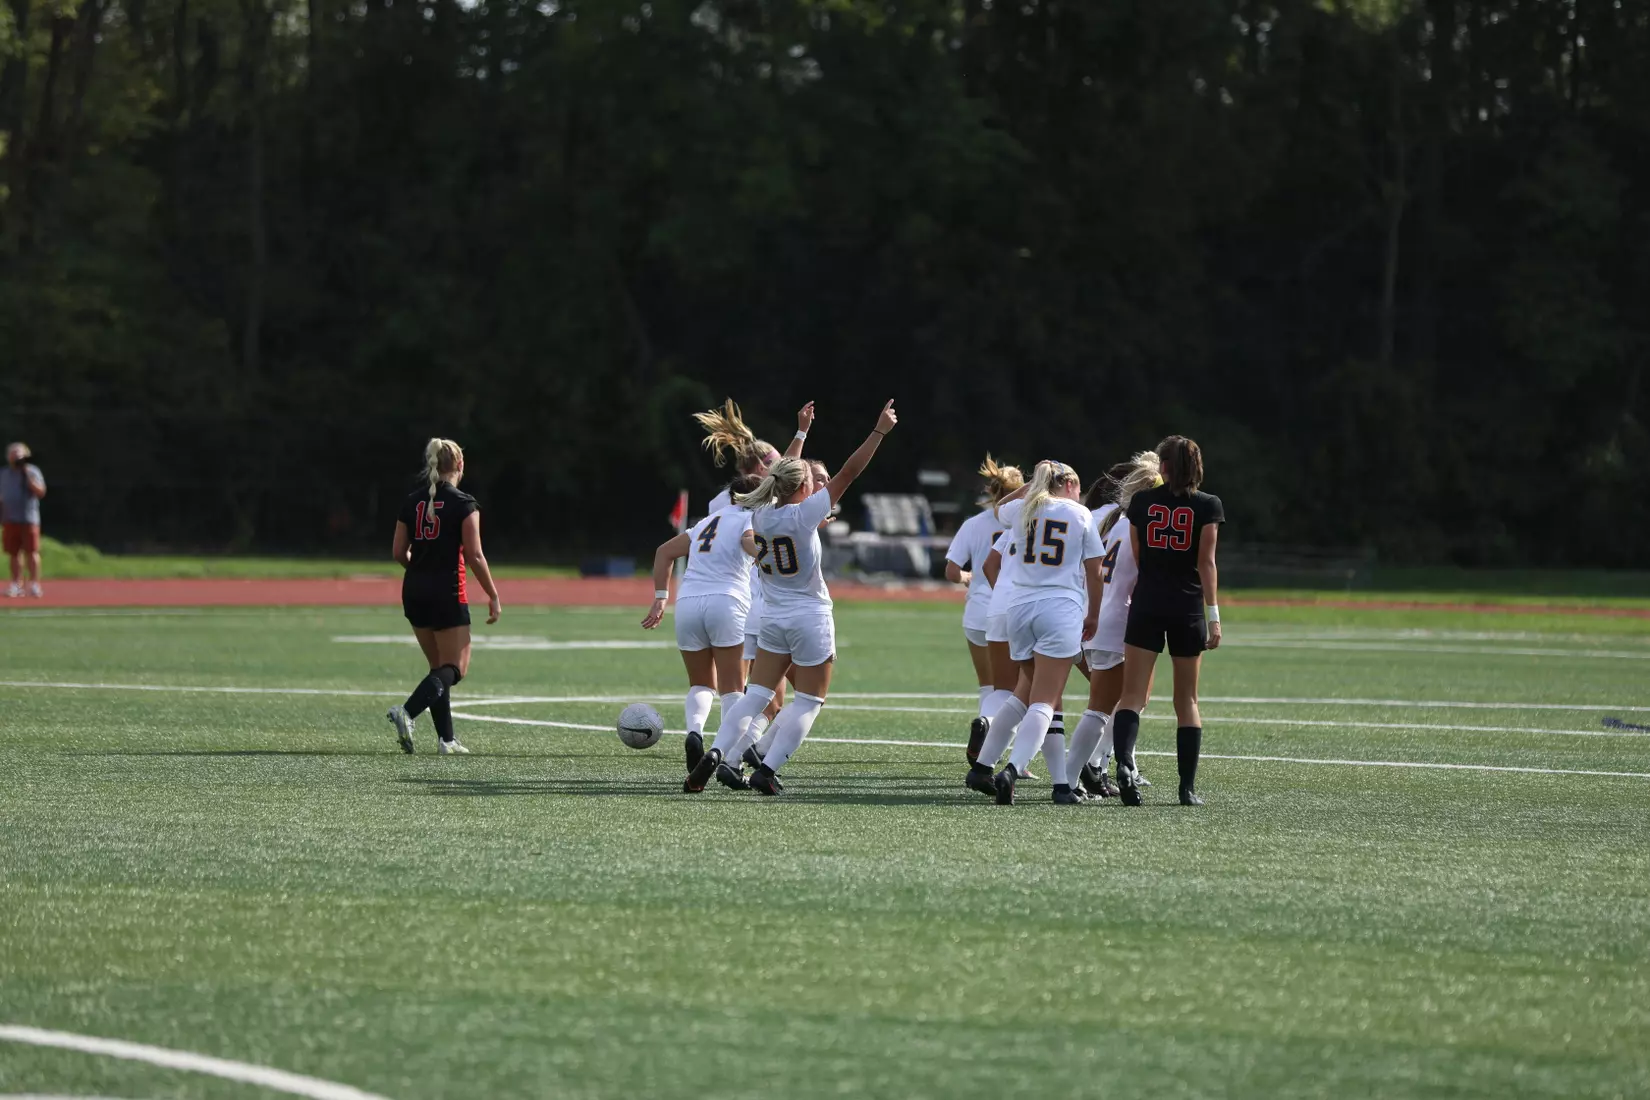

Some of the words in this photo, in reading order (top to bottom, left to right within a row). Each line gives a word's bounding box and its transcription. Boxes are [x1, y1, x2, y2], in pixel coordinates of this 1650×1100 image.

[414, 500, 444, 540] 15
[696, 515, 722, 553] 4
[1023, 517, 1069, 568] 15
[1147, 503, 1194, 551] 29
[753, 533, 799, 577] 20
[1101, 538, 1122, 584] 4
